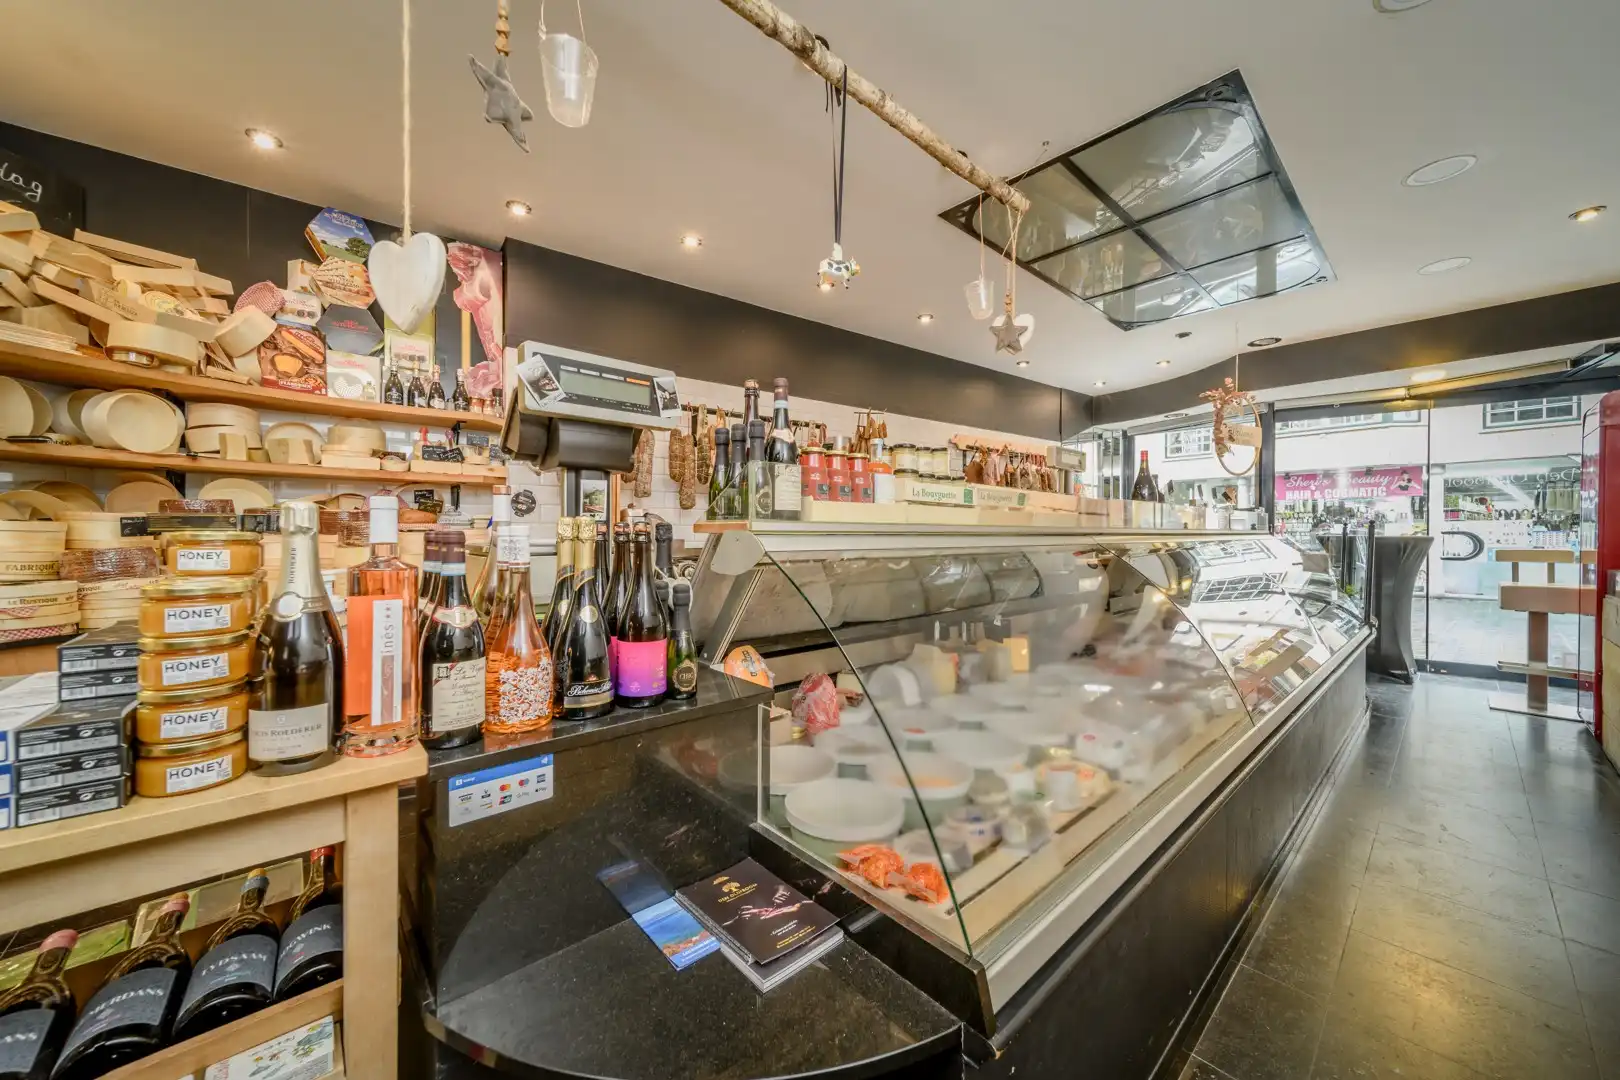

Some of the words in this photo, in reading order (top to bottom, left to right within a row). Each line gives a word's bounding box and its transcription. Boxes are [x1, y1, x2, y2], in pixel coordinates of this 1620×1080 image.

[912, 487, 920, 498] La
[1286, 489, 1311, 501] HAIR
[179, 551, 223, 560] HONEY
[167, 606, 223, 621] HONEY
[164, 656, 221, 673] HONEY
[162, 710, 220, 726] HONEY
[169, 758, 225, 780] HONEY
